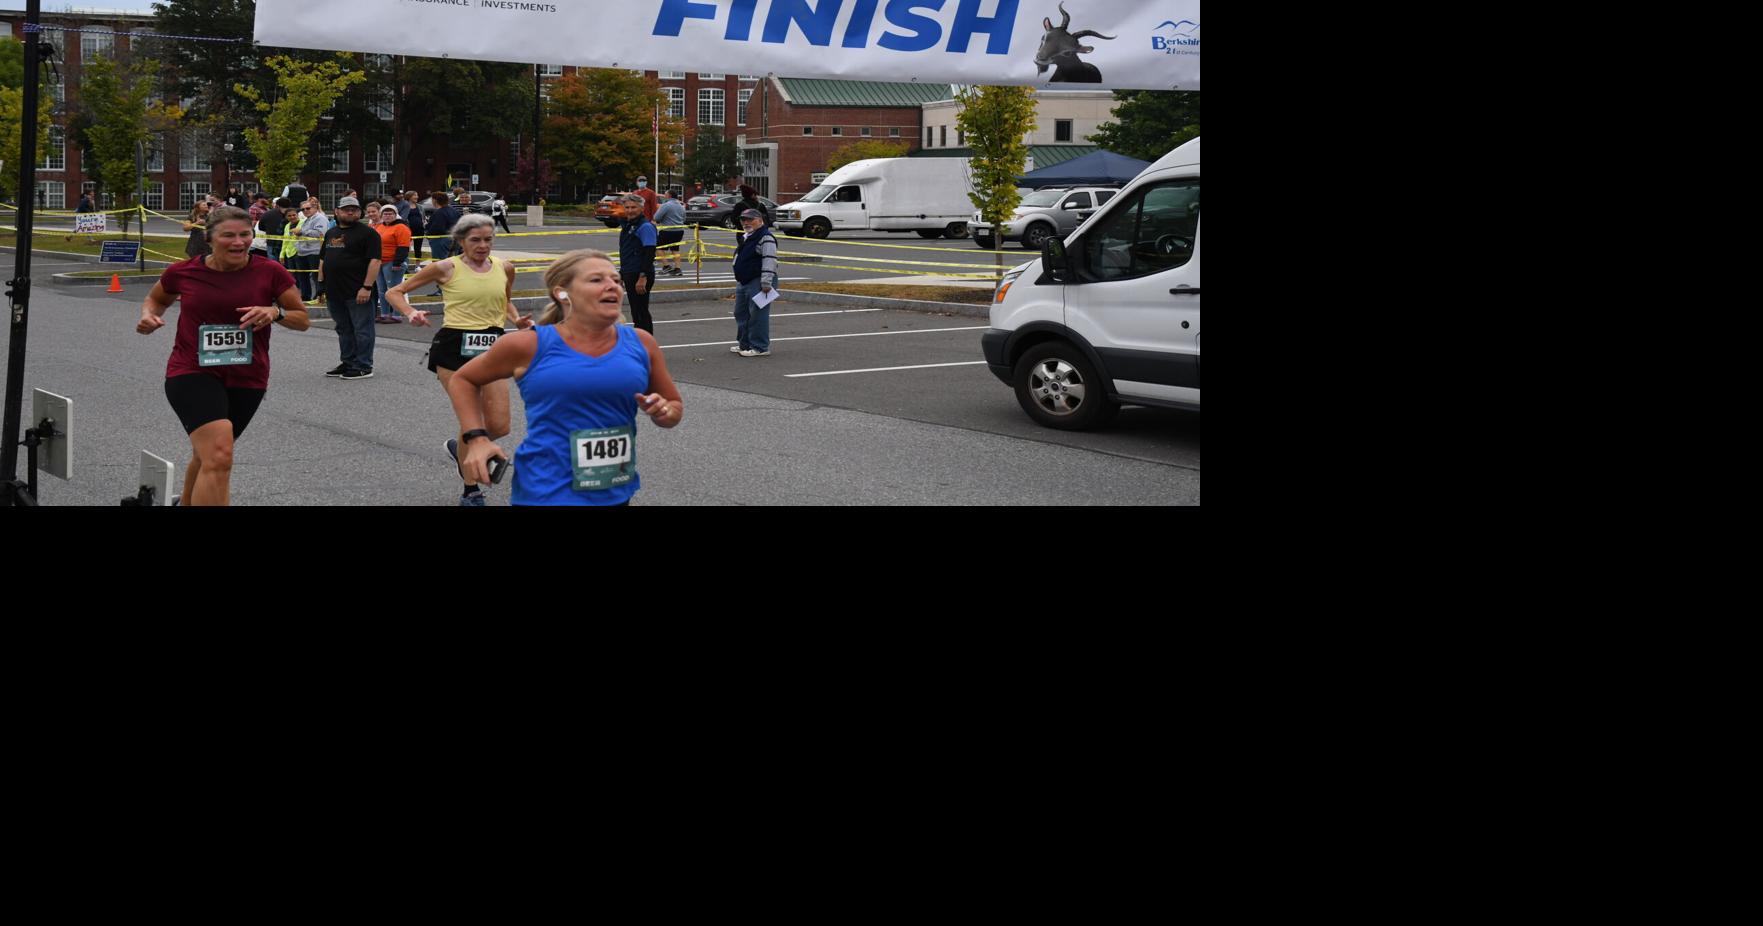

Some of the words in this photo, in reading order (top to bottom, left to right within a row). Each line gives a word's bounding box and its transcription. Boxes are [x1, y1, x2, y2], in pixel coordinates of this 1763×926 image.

[481, 0, 556, 12] INVESTMENTS
[652, 0, 1020, 55] FINISH
[205, 331, 246, 346] 1559
[468, 335, 496, 346] 1499
[582, 438, 627, 460] 1487
